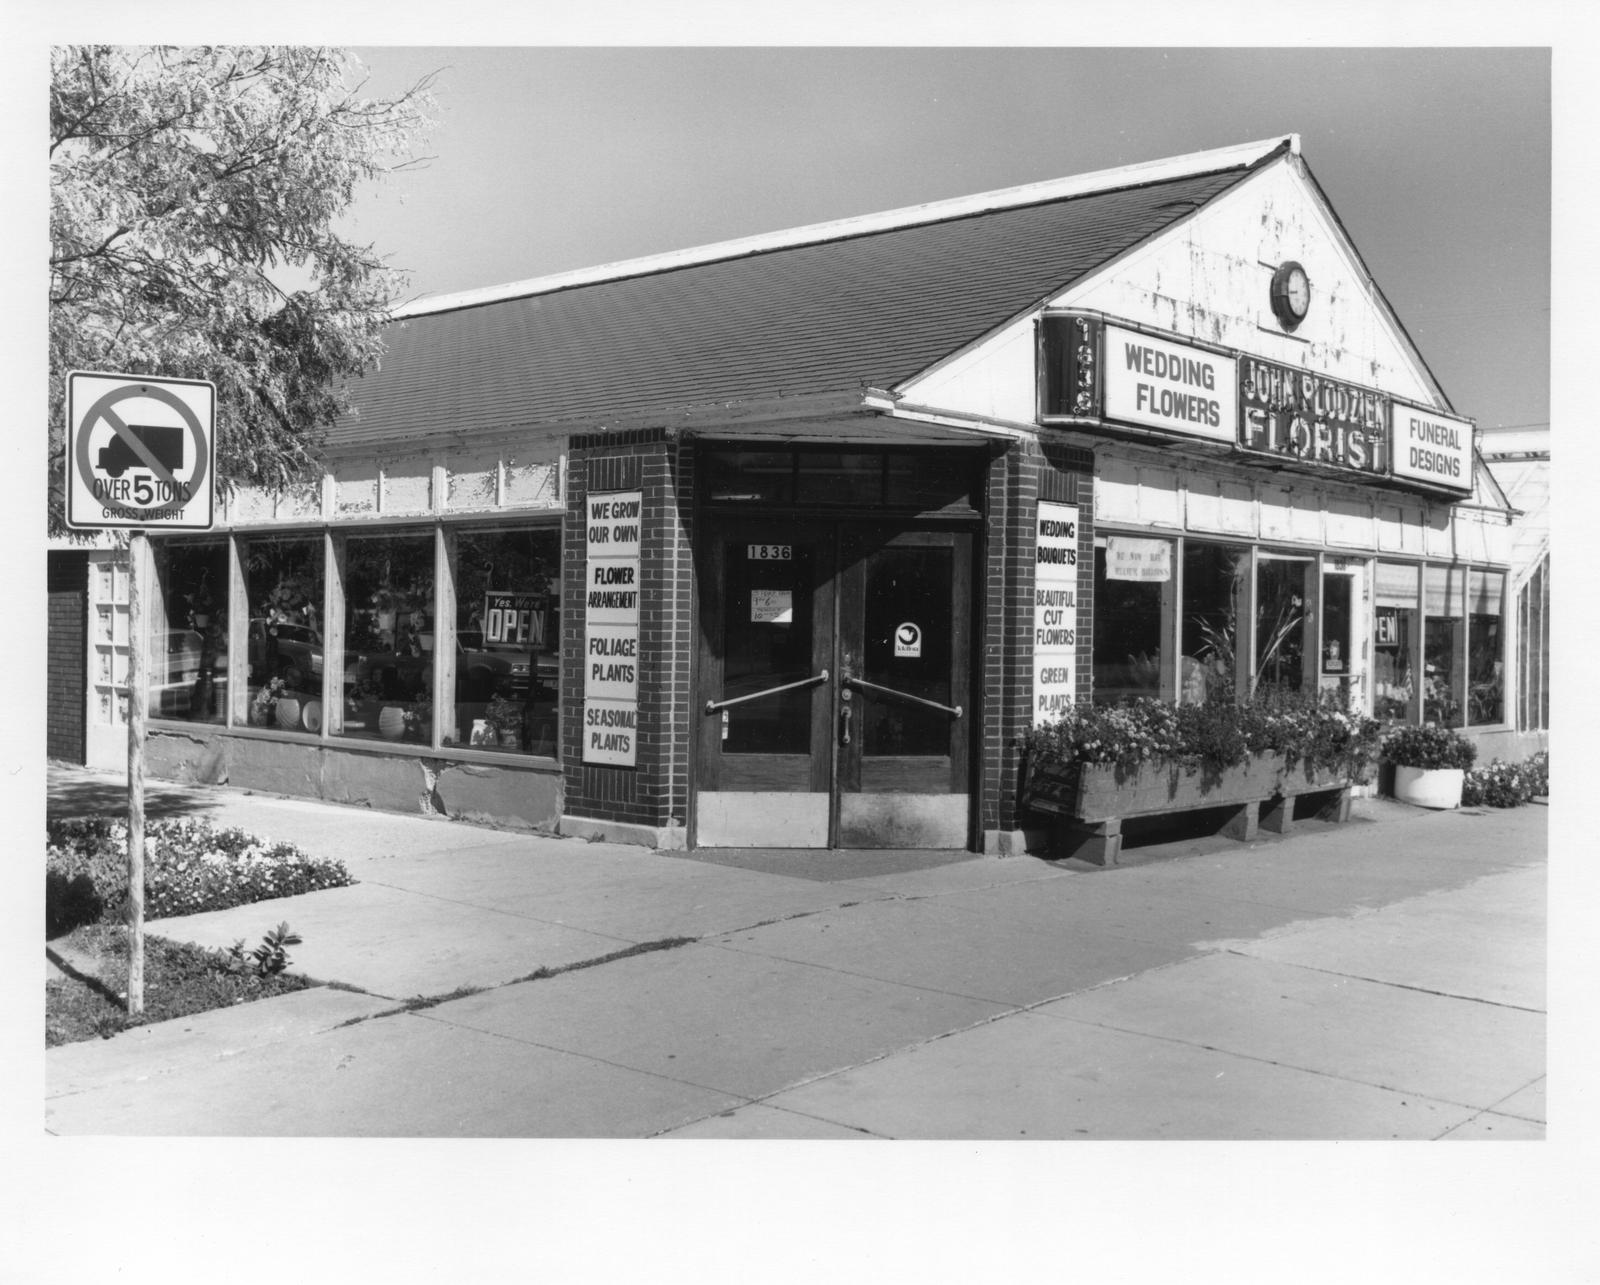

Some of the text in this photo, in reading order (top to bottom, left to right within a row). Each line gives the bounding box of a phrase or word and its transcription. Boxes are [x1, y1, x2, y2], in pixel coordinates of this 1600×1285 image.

[1125, 342, 1215, 391] WEDDING
[1244, 360, 1294, 406] JOHN
[1136, 383, 1220, 428] FLOWERS
[1245, 406, 1385, 471] FLORIST
[1410, 418, 1461, 450] FUNERAL
[1410, 447, 1460, 478] DESIGNS
[92, 475, 191, 505] OVER 5 TONS
[102, 507, 185, 520] GROSS WEIGHT
[591, 501, 640, 520] WE GROW
[588, 525, 638, 543] OUR OWN
[1039, 519, 1075, 539] WEDDING
[751, 546, 791, 559] 1836
[1037, 546, 1077, 566] BOUQUETS
[594, 567, 635, 585] FLOWER
[588, 591, 638, 610] ARRANGEMENT
[1036, 589, 1076, 608] BEAUTIFUL
[487, 608, 545, 643] OPEN
[1043, 610, 1064, 626] CUT
[589, 638, 637, 657] FOLIAGE
[1036, 629, 1075, 646] FLOWERS
[592, 663, 635, 683] PLANTS
[1040, 667, 1068, 684] GREEN
[1038, 694, 1073, 713] PLANTS
[586, 708, 637, 730] SEASONAL
[591, 732, 631, 753] PLANTS
